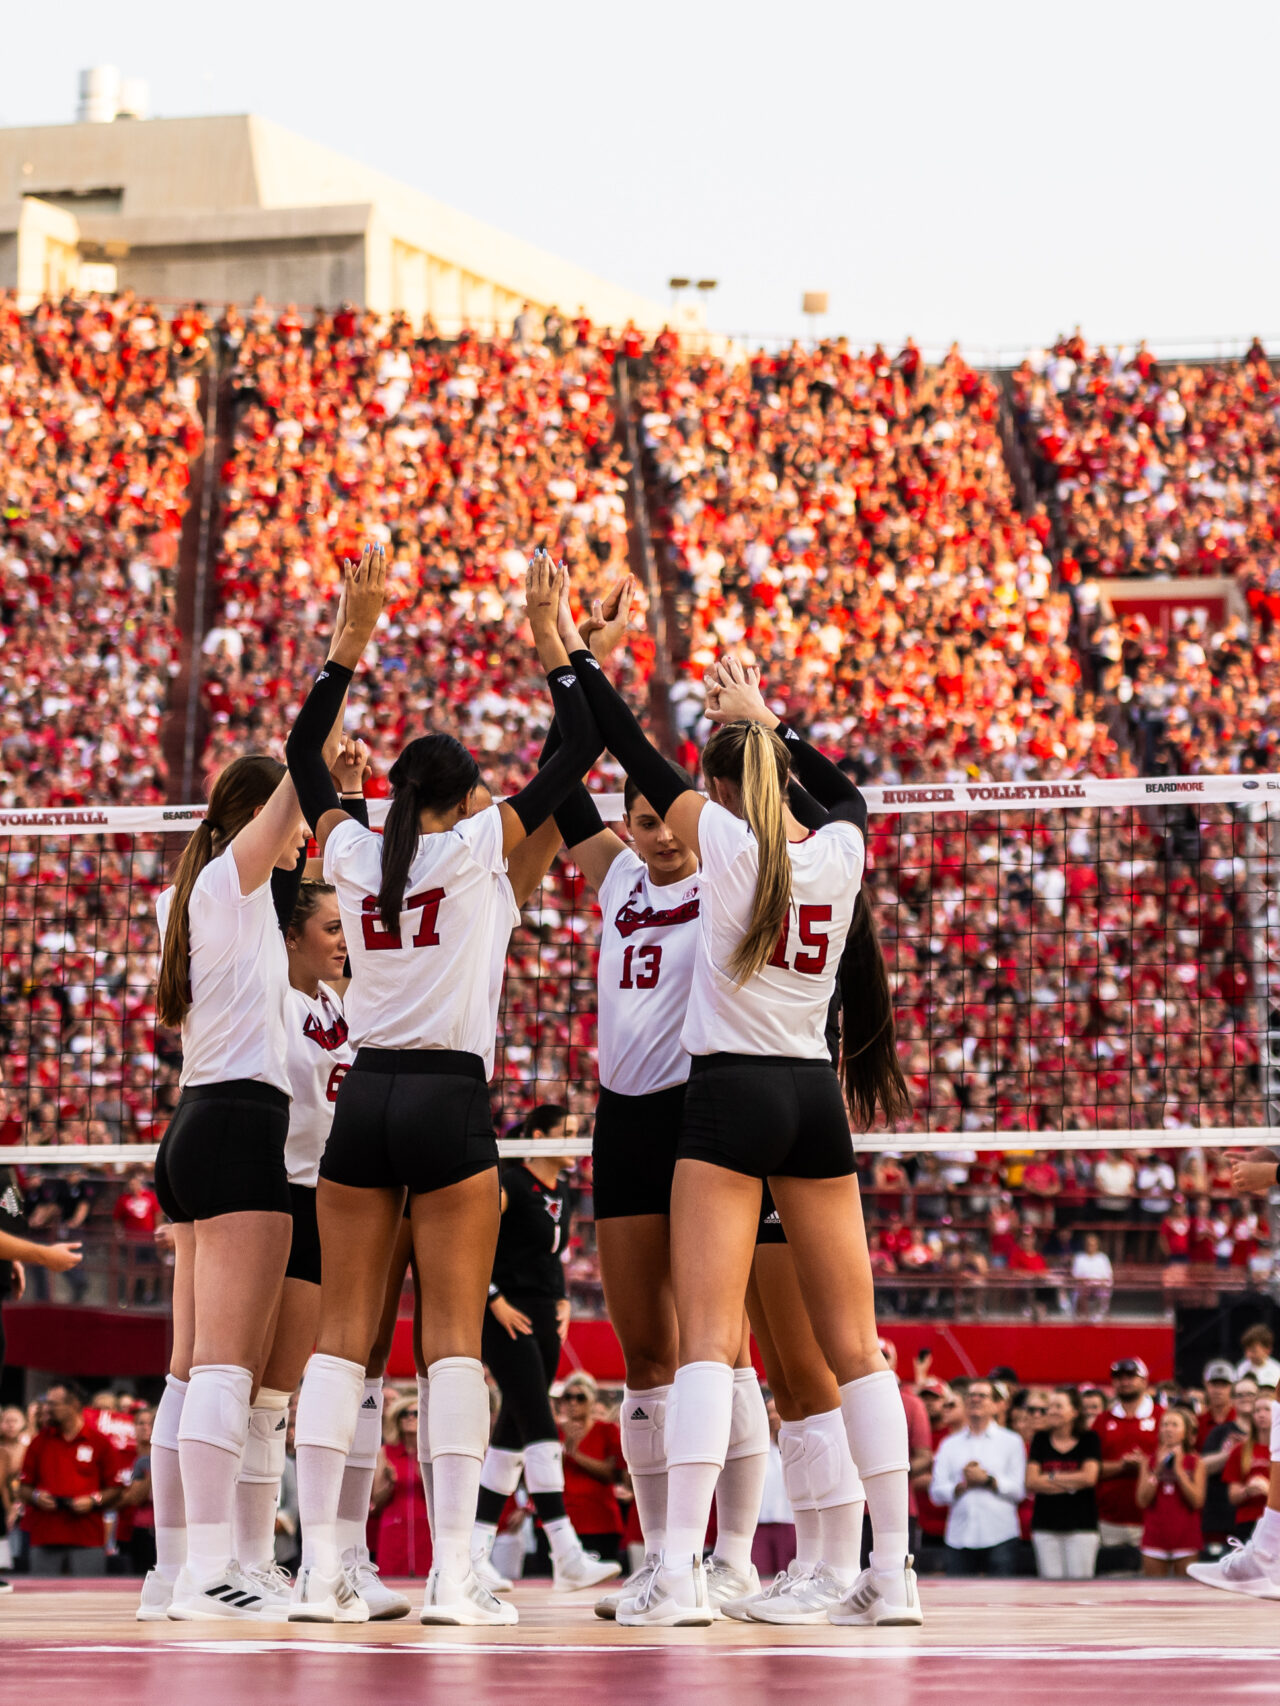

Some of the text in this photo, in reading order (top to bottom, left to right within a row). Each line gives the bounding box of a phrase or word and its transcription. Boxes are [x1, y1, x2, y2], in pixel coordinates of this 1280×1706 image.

[882, 784, 1086, 804] HUSKER VOLLEYBALL
[1145, 782, 1205, 793] BEARDMORE
[619, 944, 663, 990] 13
